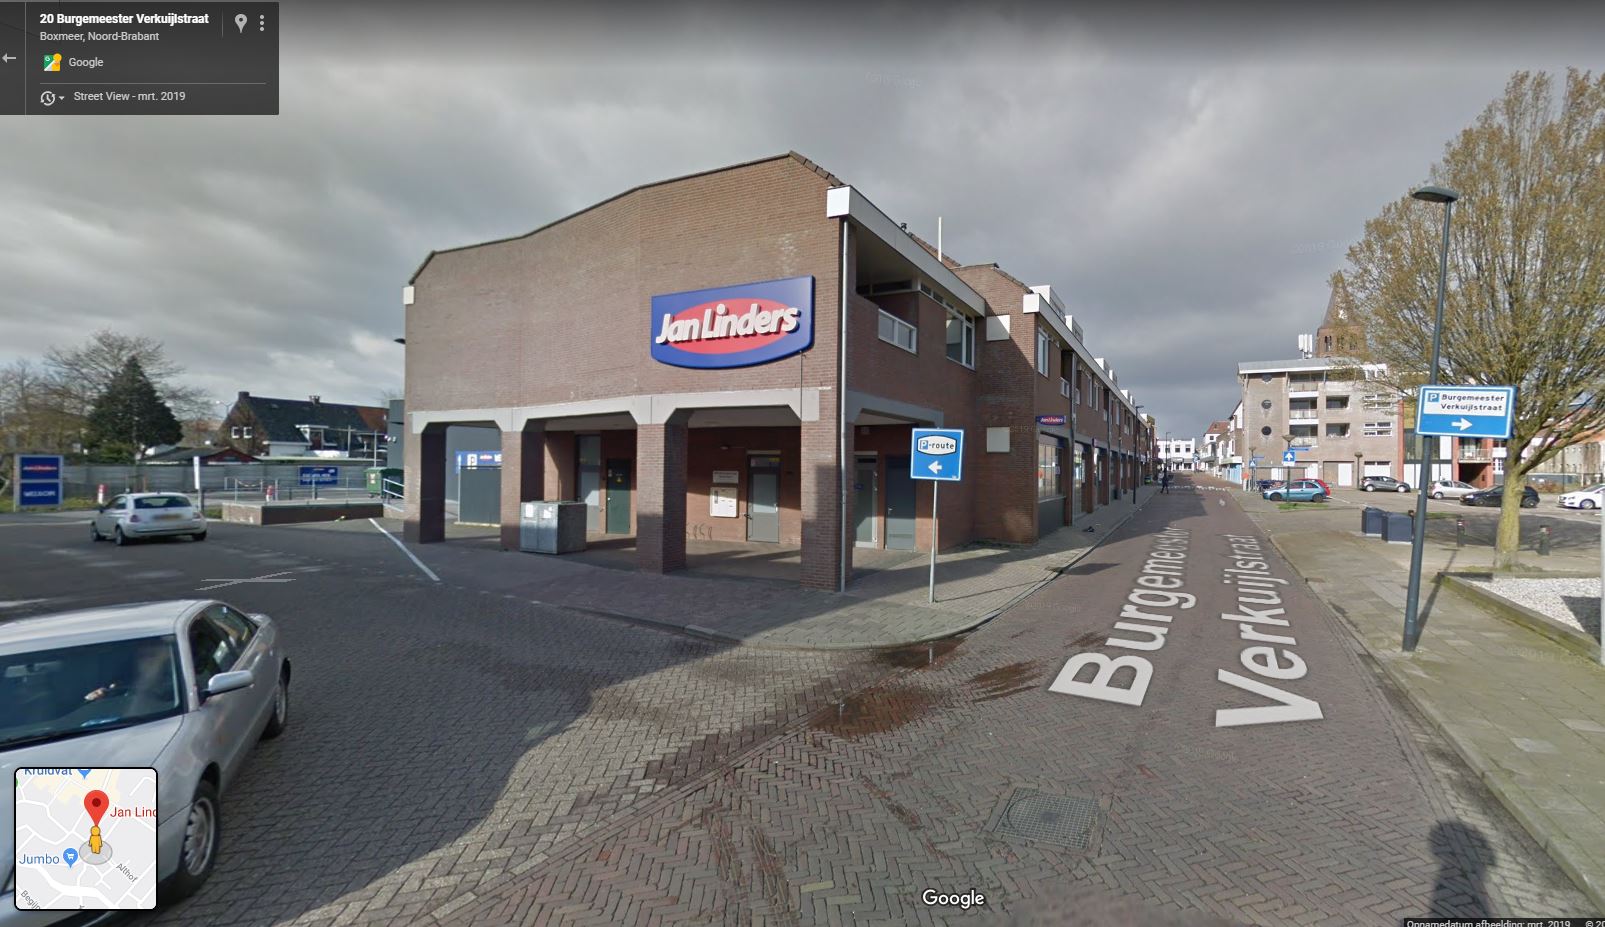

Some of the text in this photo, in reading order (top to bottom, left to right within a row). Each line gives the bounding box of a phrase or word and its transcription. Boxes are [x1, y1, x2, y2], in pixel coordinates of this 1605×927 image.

[656, 303, 800, 344] Jan Linders
[1441, 394, 1504, 402] Burgemeester
[1441, 403, 1502, 412] Verkuijlstraat
